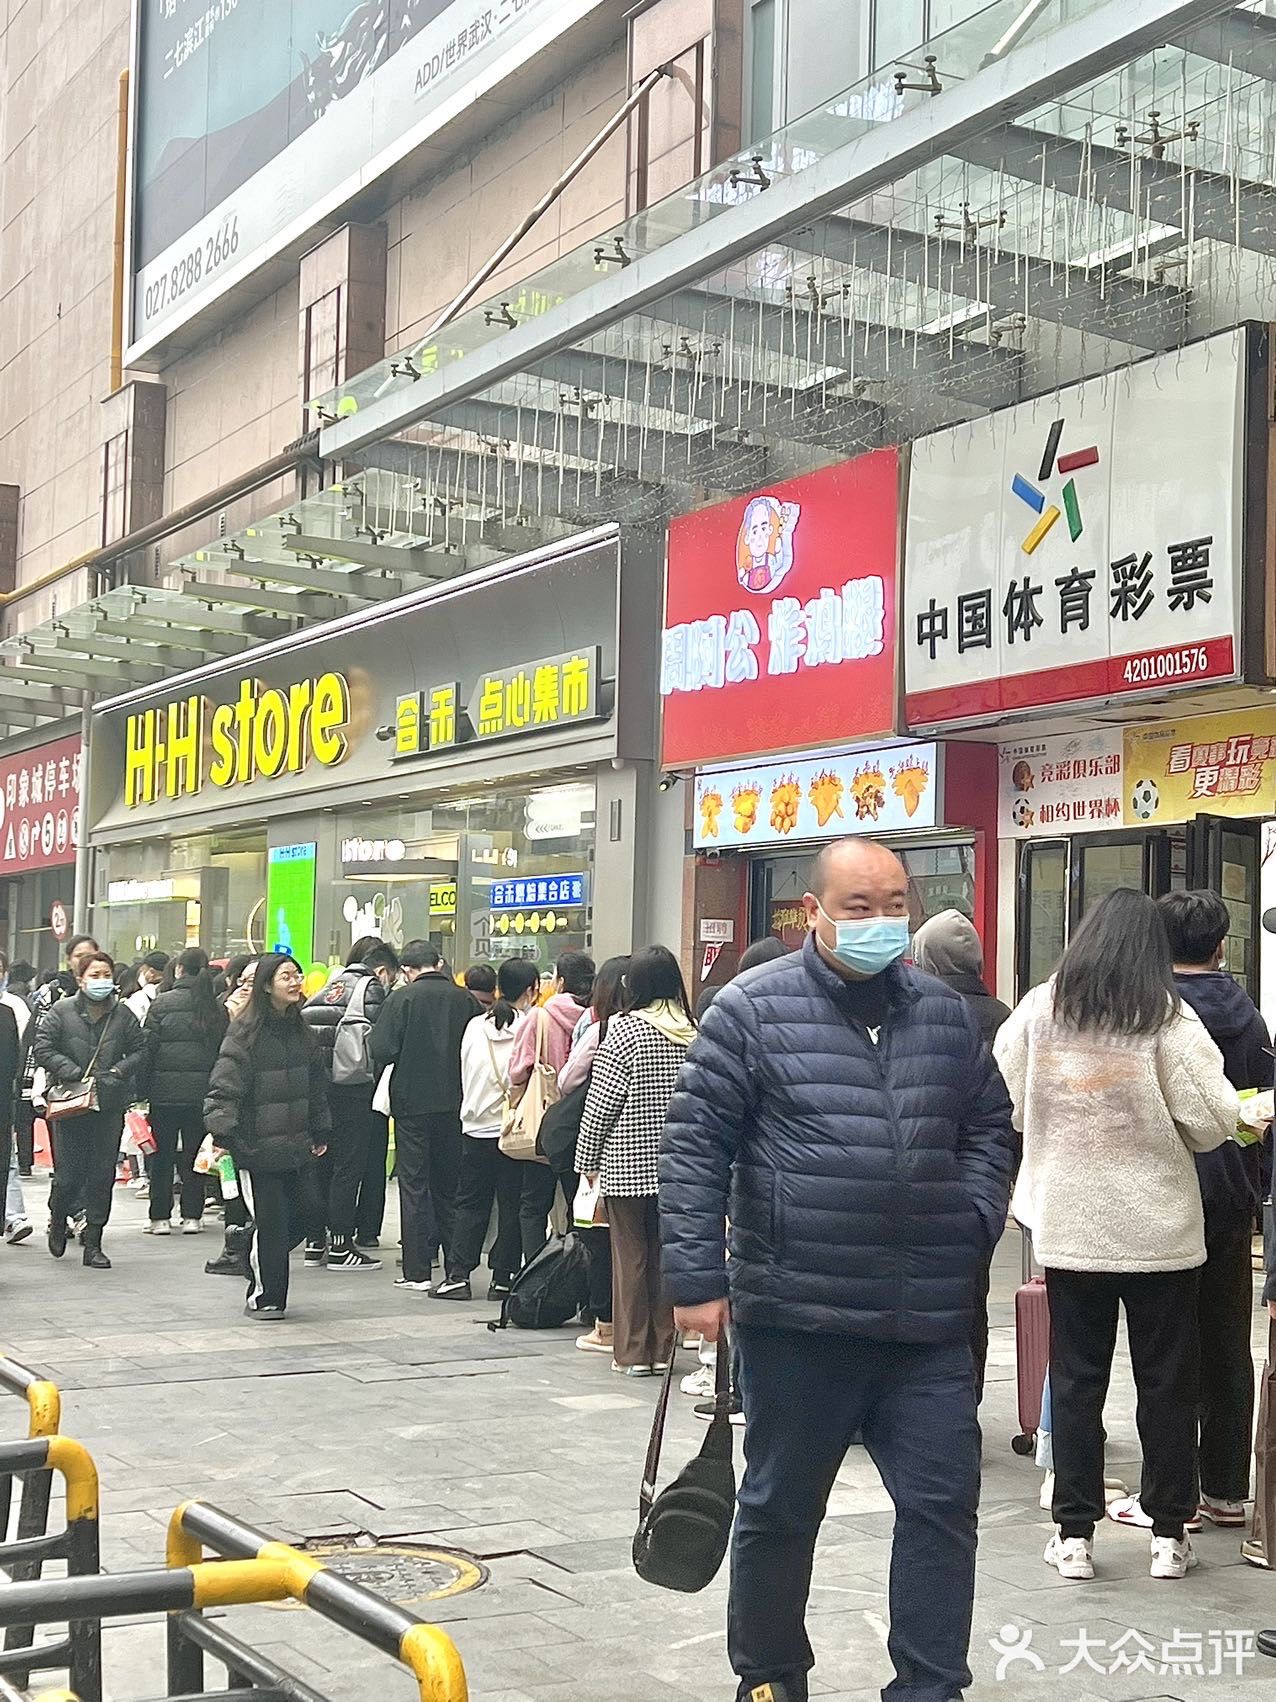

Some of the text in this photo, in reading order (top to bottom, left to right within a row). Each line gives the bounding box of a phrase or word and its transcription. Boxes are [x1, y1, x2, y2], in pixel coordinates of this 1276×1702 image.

[145, 216, 239, 320] 027.8288 2666
[917, 535, 1213, 659] 中国体育彩票
[1123, 646, 1208, 683] 4201001576
[396, 655, 590, 752] 合禾 点心集市
[209, 672, 349, 788] store
[1040, 754, 1121, 783] 竞彩俱乐部
[1168, 735, 1276, 773] 看赛事玩竞
[1192, 763, 1261, 798] 更精彩
[1039, 797, 1121, 824] 相约世界杯
